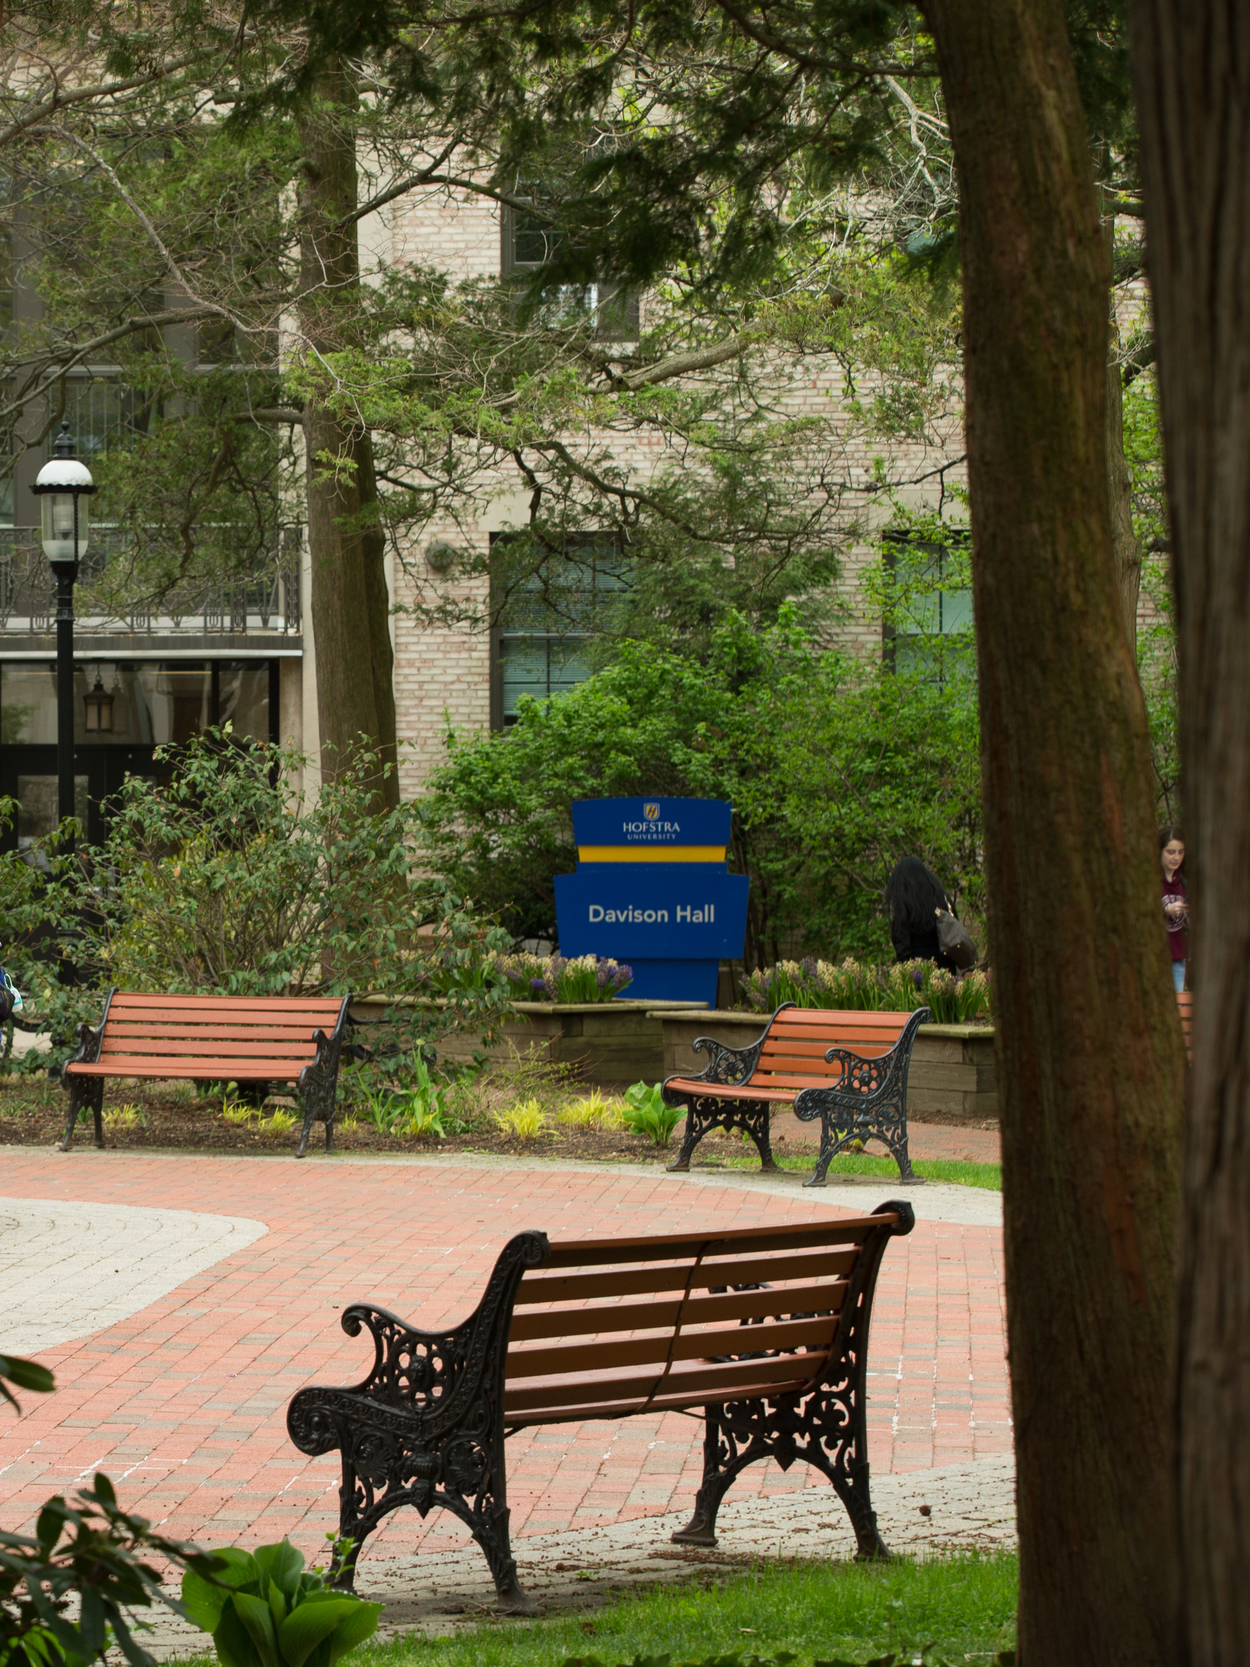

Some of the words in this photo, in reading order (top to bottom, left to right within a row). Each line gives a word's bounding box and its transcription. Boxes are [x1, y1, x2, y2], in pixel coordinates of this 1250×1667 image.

[623, 821, 680, 833] HOFSTRA
[588, 904, 669, 923] Davison
[676, 904, 715, 923] Hall
